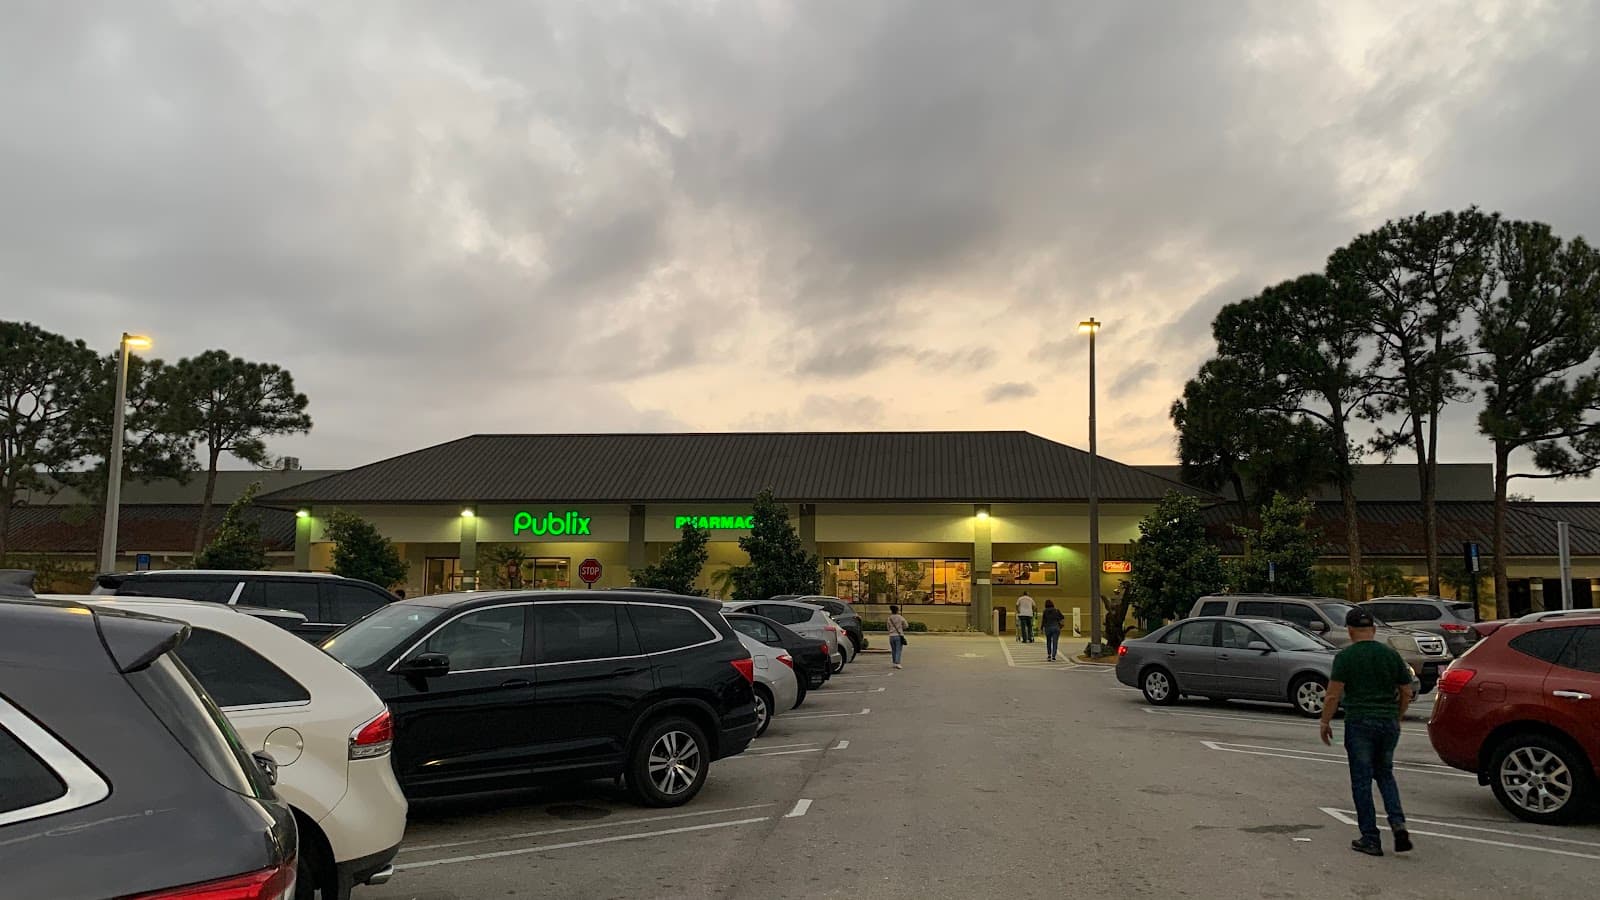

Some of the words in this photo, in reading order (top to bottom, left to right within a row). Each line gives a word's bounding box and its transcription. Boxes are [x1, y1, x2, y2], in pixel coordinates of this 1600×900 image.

[513, 511, 591, 536] Publix
[675, 515, 755, 530] PHARMAC
[581, 566, 600, 576] STOP
